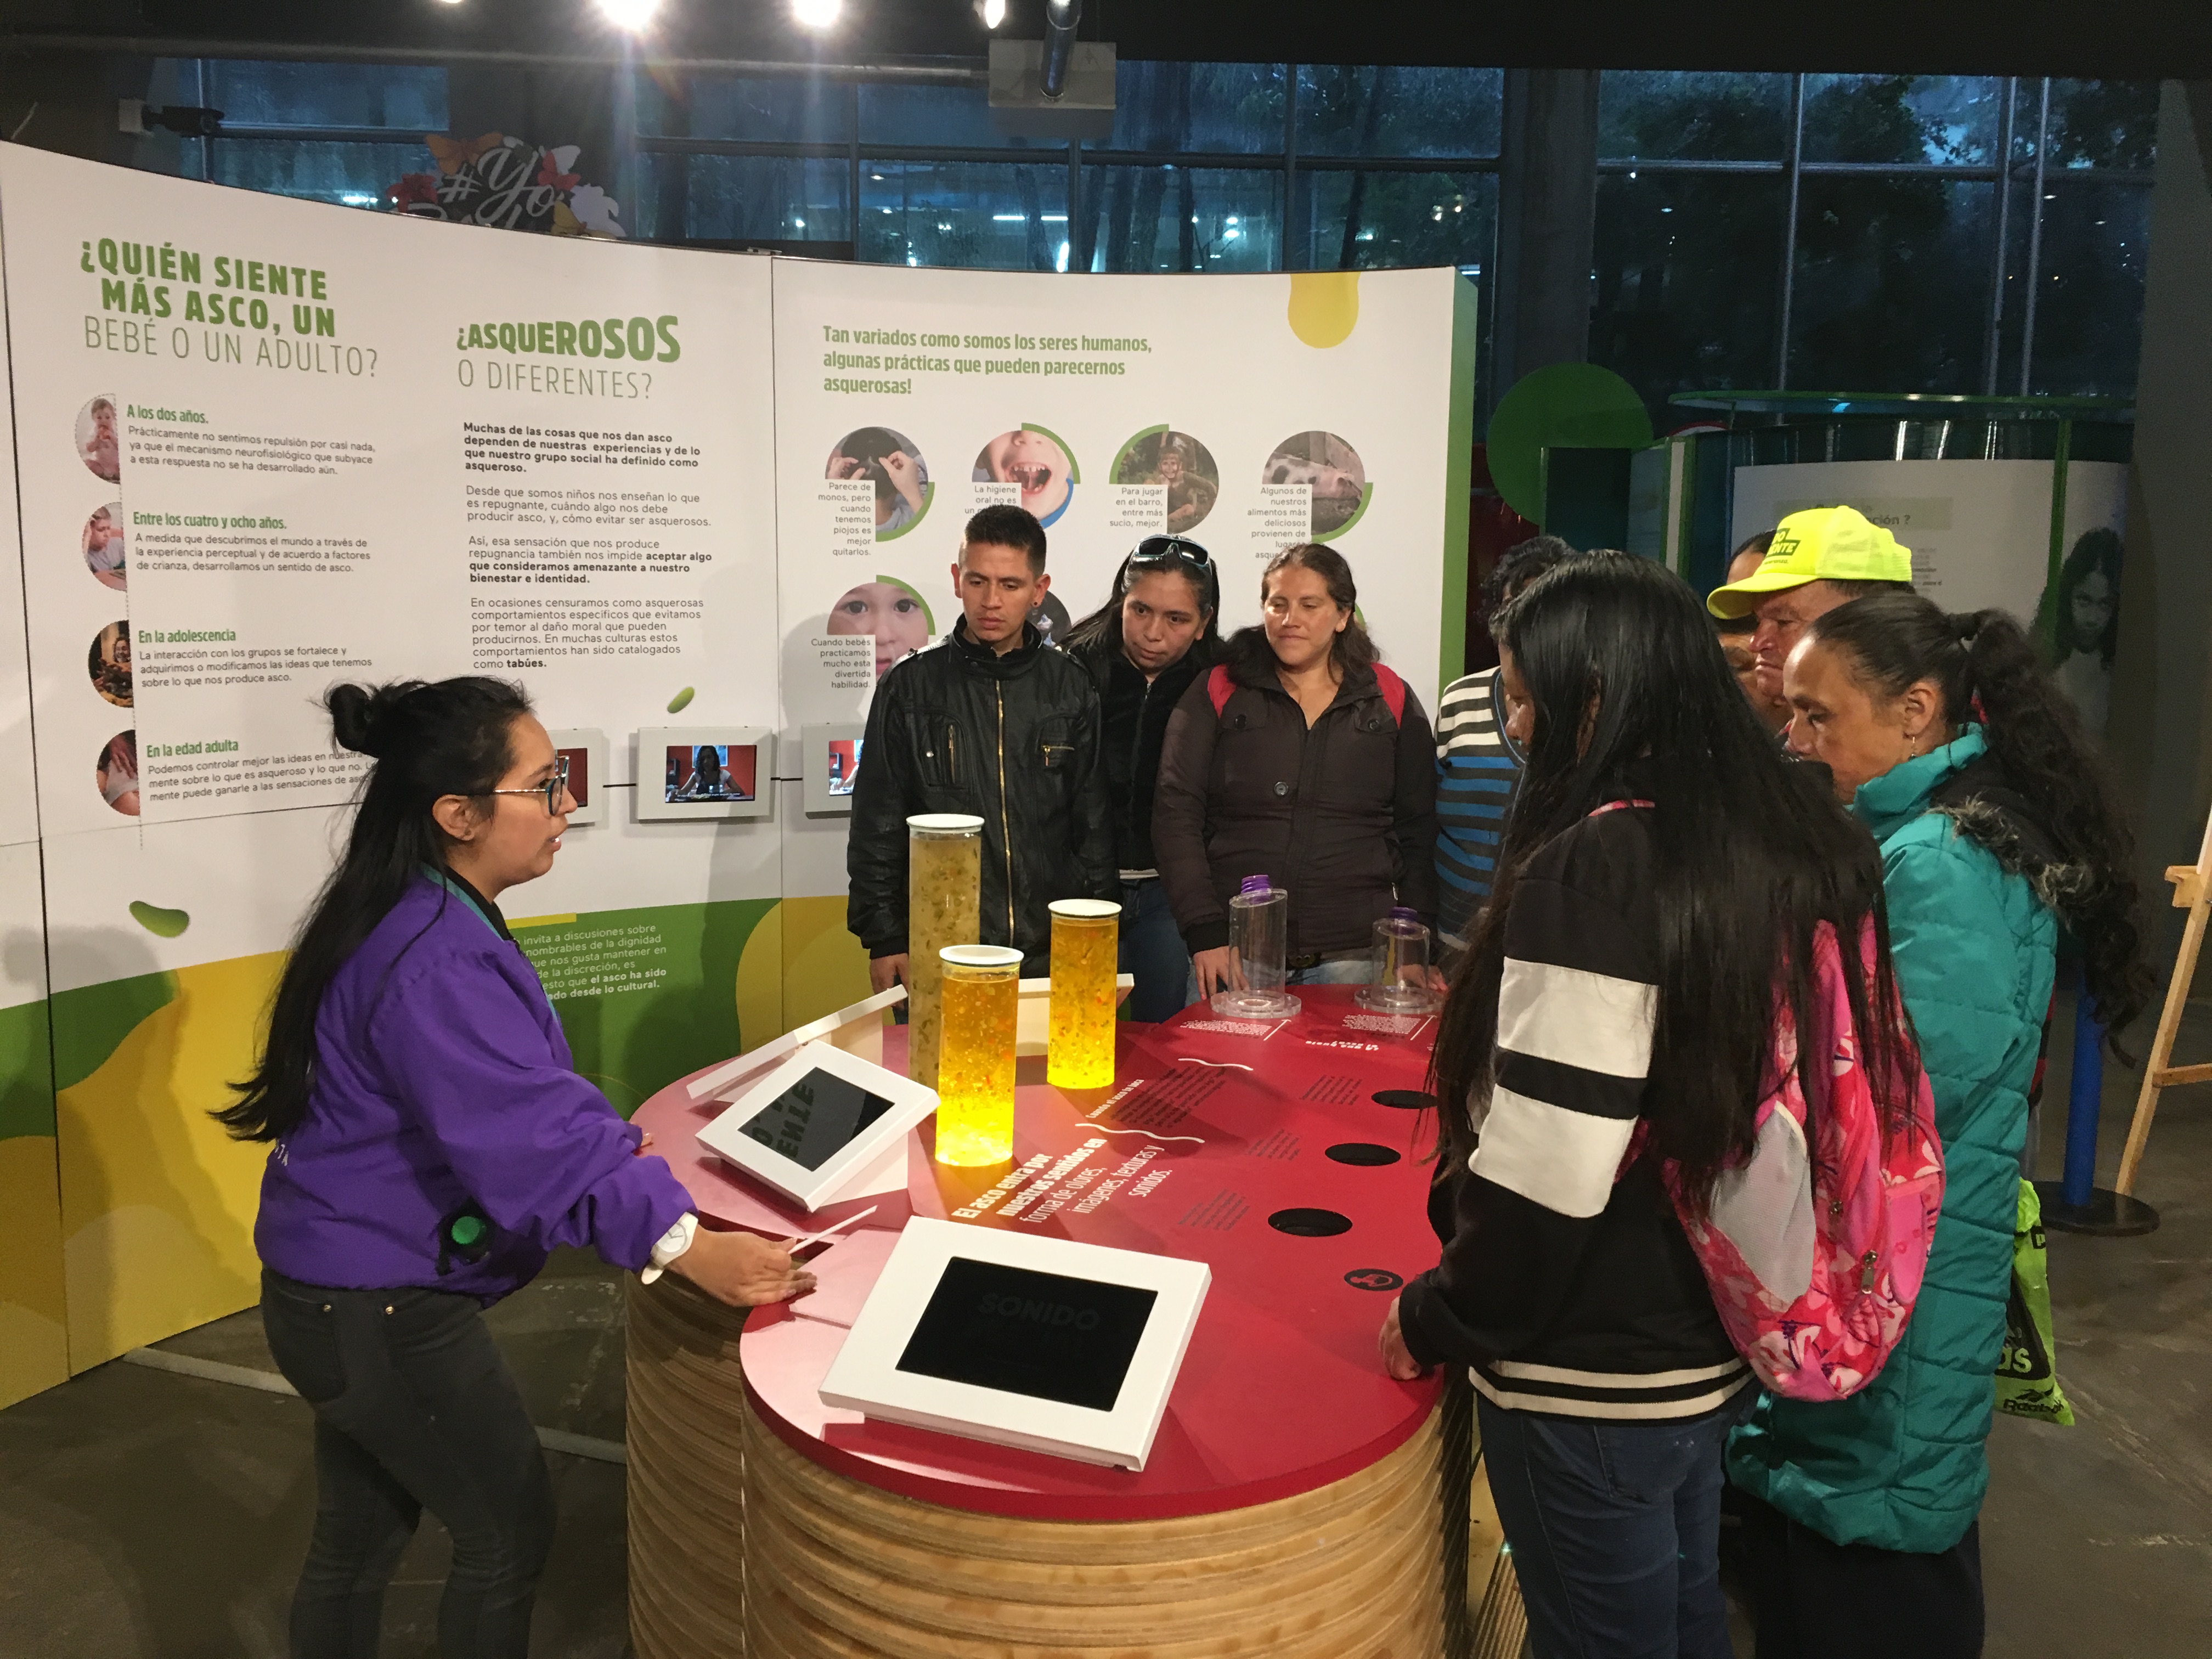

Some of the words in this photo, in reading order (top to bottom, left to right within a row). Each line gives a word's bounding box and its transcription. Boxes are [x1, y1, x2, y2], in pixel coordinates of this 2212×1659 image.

[81, 238, 201, 284] ¿QUIÉN
[215, 257, 328, 301] SIENTE
[101, 277, 172, 318] MÁS
[185, 291, 280, 335] ASCO,
[293, 304, 336, 337] UN
[84, 315, 157, 356] BEBÉ
[172, 327, 189, 358] O
[205, 330, 241, 364] UN
[256, 337, 378, 377] ADULTO?
[456, 315, 681, 363] ¿ASQUEROSOS
[823, 325, 849, 343] Tan
[853, 329, 917, 346] variados
[921, 334, 960, 348] como
[964, 335, 1011, 349] somos
[1015, 334, 1036, 350] los
[1039, 337, 1077, 351] seres
[1082, 335, 1152, 353] humanos,
[823, 351, 881, 370] algunas
[884, 354, 950, 371] prácticas
[954, 359, 981, 374] que
[985, 358, 1040, 375] pueden
[1044, 362, 1125, 376] parecernos
[459, 359, 473, 387] O
[488, 362, 652, 399] DIFERENTES?
[824, 378, 911, 394] asquerosas!
[127, 404, 135, 418] A
[138, 405, 154, 420] los
[156, 407, 177, 421] dos
[179, 410, 208, 424] años.
[128, 425, 199, 440] Prácticamente
[218, 434, 262, 444] sentimos
[264, 437, 308, 447] repulsión
[311, 441, 327, 449] por
[330, 441, 348, 450] casi
[351, 443, 375, 453] nada,
[464, 422, 506, 434] Muchas
[509, 425, 523, 435] de
[526, 426, 541, 436] las
[545, 430, 575, 438] cosas
[579, 431, 599, 440] que
[625, 432, 644, 441] dan
[464, 435, 520, 447] dependen
[523, 438, 536, 448] de
[540, 442, 586, 450] nuestras
[593, 443, 662, 454] experiencias
[665, 448, 671, 456] y
[674, 446, 687, 455] de
[691, 446, 700, 455] lo
[465, 450, 485, 459] que
[489, 451, 531, 460] nuestro
[534, 454, 567, 464] grupo
[571, 454, 602, 463] social
[605, 455, 618, 464] ha
[621, 455, 666, 466] definido
[465, 462, 526, 472] asqueroso.
[829, 482, 857, 490] Parece
[1142, 488, 1163, 496] jugar
[1138, 498, 1163, 506] barro,
[133, 511, 162, 526] Entre
[165, 512, 182, 526] los
[184, 515, 219, 527] cuatro
[221, 517, 228, 529] y
[230, 515, 256, 528] ocho
[258, 516, 287, 529] años.
[1110, 520, 1133, 528] sucio,
[1136, 520, 1163, 528] mejor.
[834, 526, 859, 535] piojos
[847, 537, 871, 546] mejor
[469, 550, 535, 560] repugnancia
[538, 550, 581, 559] también
[607, 551, 642, 561] impide
[646, 552, 687, 562] aceptar
[690, 552, 712, 563] algo
[832, 548, 871, 556] quitarlos.
[469, 563, 489, 572] que
[493, 561, 569, 571] consideramos
[573, 563, 637, 572] amenazante
[650, 564, 690, 572] nuestro
[470, 573, 522, 583] bienestar
[535, 573, 590, 583] identidad.
[471, 610, 566, 622] comportamientos
[569, 610, 629, 620] específicos
[632, 612, 651, 620] que
[655, 610, 701, 619] evitamos
[138, 630, 152, 644] En
[155, 630, 165, 643] la
[167, 629, 236, 643] adolescencia
[820, 649, 871, 658] practicamos
[269, 661, 283, 669] las
[285, 659, 310, 669] ideas
[312, 661, 329, 669] que
[506, 658, 546, 668] tabúes.
[832, 680, 870, 689] habilidad.
[146, 744, 160, 758] En
[162, 744, 172, 757] la
[175, 741, 202, 755] edad
[205, 739, 239, 753] adulta
[524, 935, 551, 945] invita
[564, 928, 624, 941] discusiones
[628, 924, 656, 934] sobre
[569, 986, 602, 998] desde
[605, 985, 615, 994] lo
[617, 980, 661, 991] cultural.
[951, 1207, 982, 1218] El
[969, 1189, 1007, 1209] asco
[996, 1168, 1036, 1189] entra
[1023, 1153, 1053, 1169] por
[996, 1180, 1054, 1216] nuestros
[1042, 1148, 1094, 1180] sentidos
[1084, 1138, 1108, 1148] en
[1066, 1179, 1129, 1214] imágenes,
[1110, 1150, 1157, 1177] texturas
[1128, 1170, 1173, 1198] sonidos.
[1019, 1200, 1065, 1223] forma
[1050, 1189, 1077, 1199] de
[1065, 1167, 1108, 1189] olores,
[978, 1292, 1101, 1330] SONIDO
